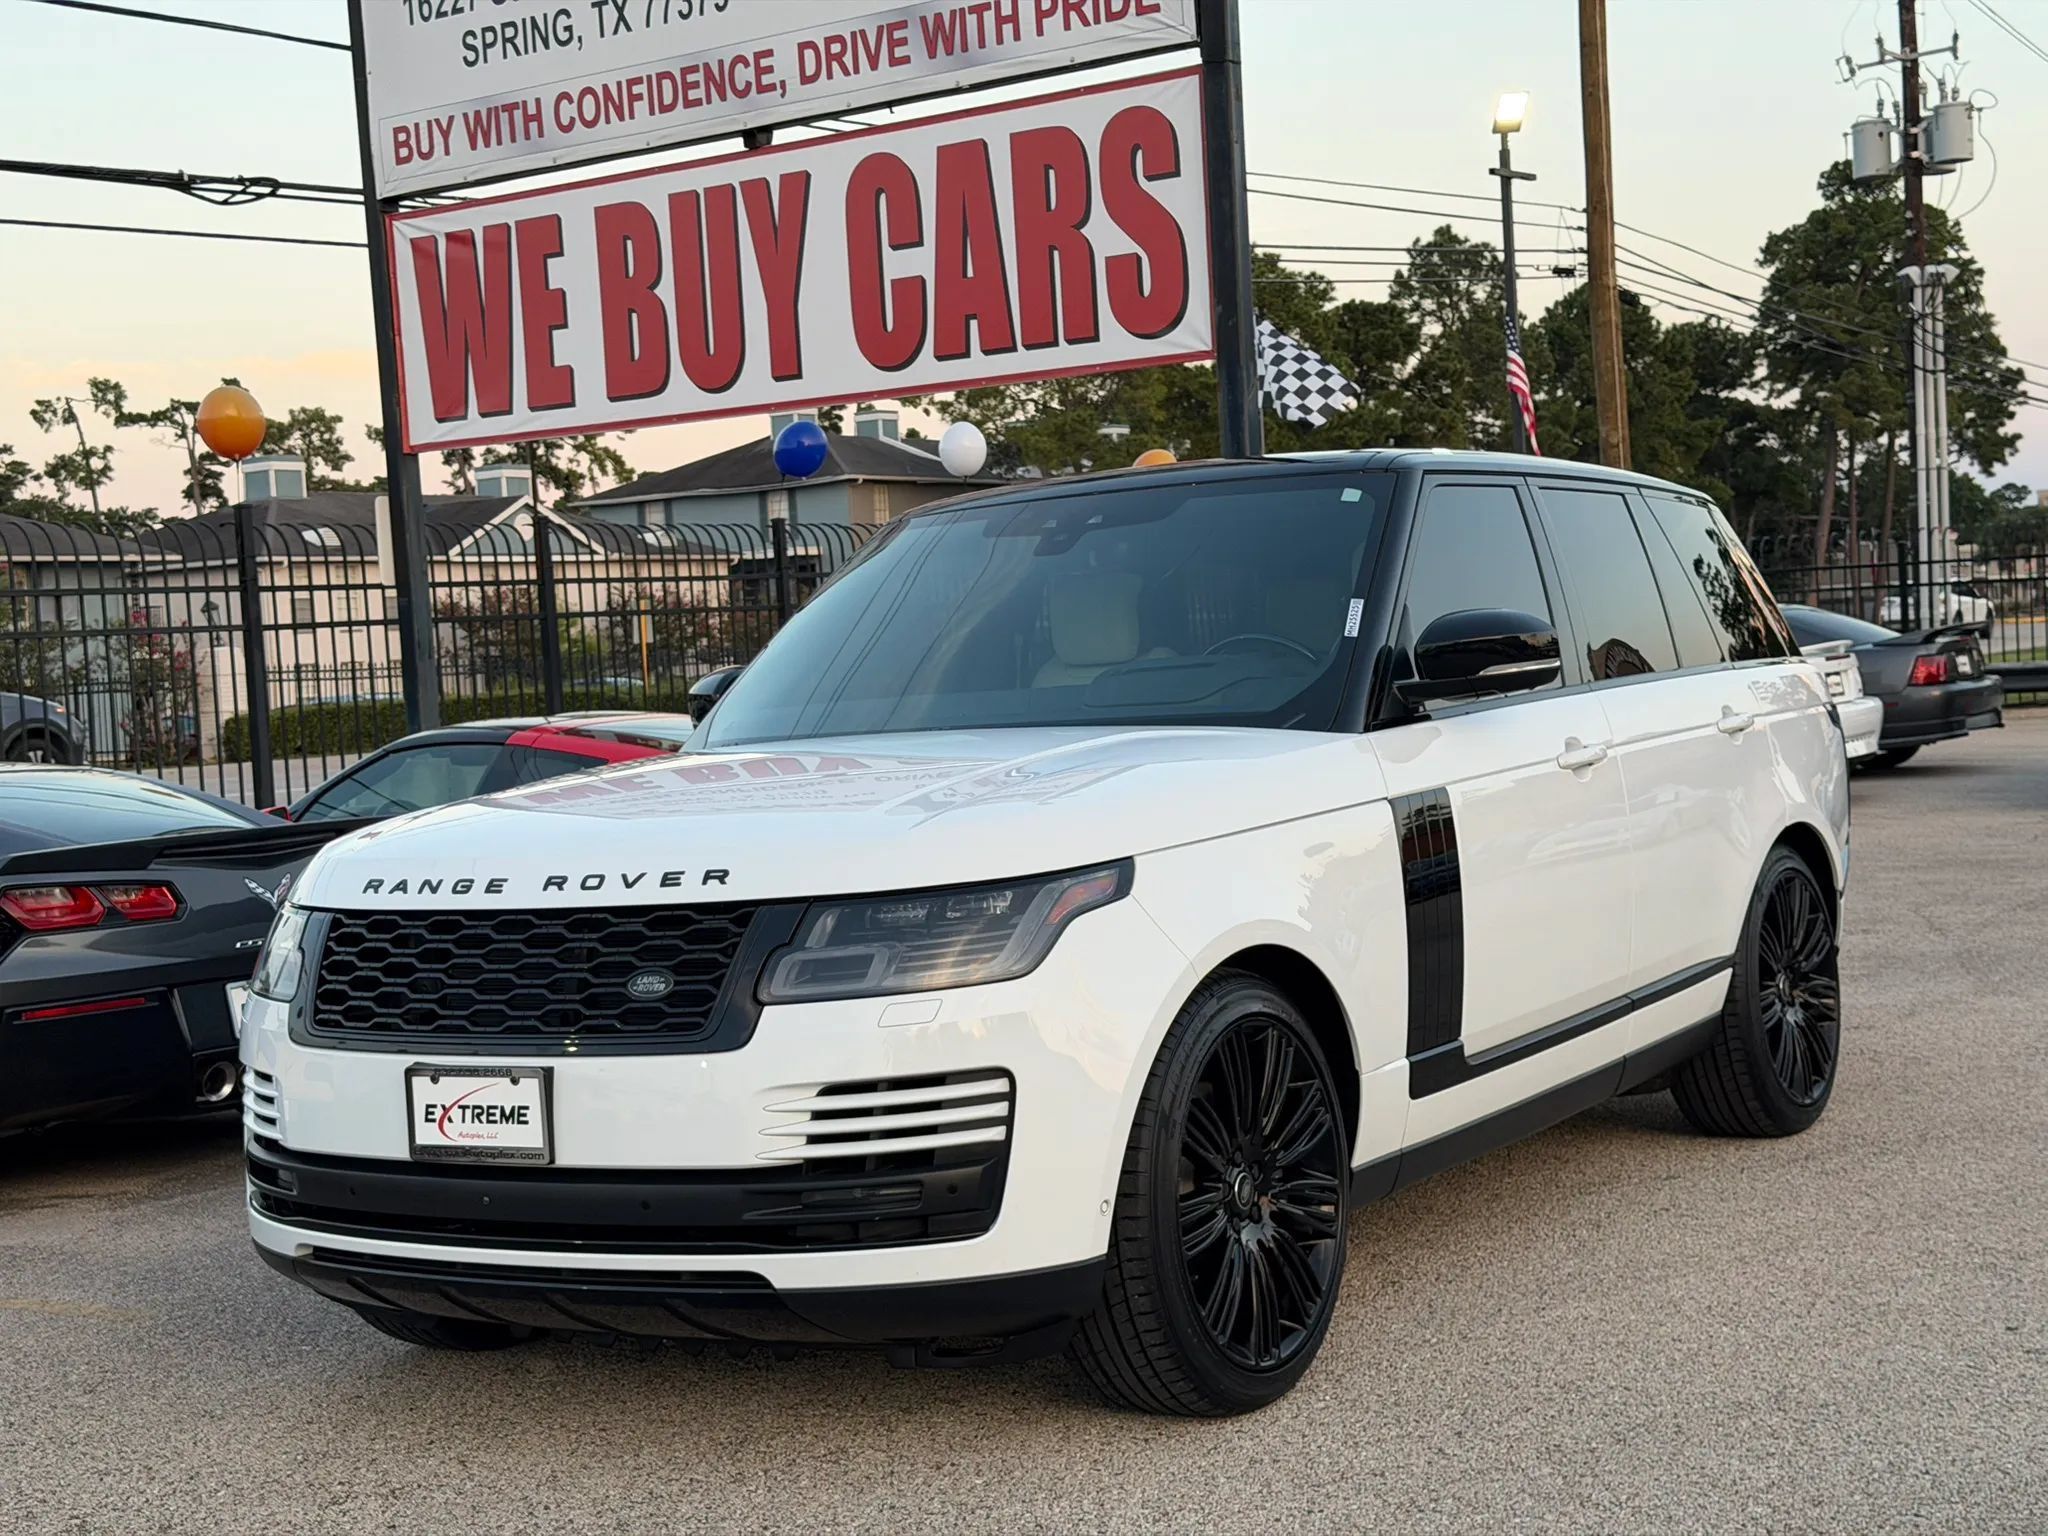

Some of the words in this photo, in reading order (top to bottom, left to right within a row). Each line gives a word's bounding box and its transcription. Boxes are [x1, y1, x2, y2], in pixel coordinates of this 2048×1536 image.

[461, 8, 584, 68] SPRING,
[591, 0, 633, 39] TX
[392, 115, 455, 166] BUY
[462, 97, 545, 151] WITH
[553, 48, 788, 133] CONFIDENCE,
[797, 20, 911, 86] DRIVE
[919, 0, 1021, 59] WITH
[410, 213, 575, 422] WE
[593, 170, 811, 402] BUY
[845, 105, 1190, 371] CARS
[362, 877, 508, 895] RANGE
[542, 868, 730, 892] ROVER
[636, 975, 660, 984] LAND
[637, 982, 666, 992] ROVER
[424, 1103, 530, 1125] EXTREME
